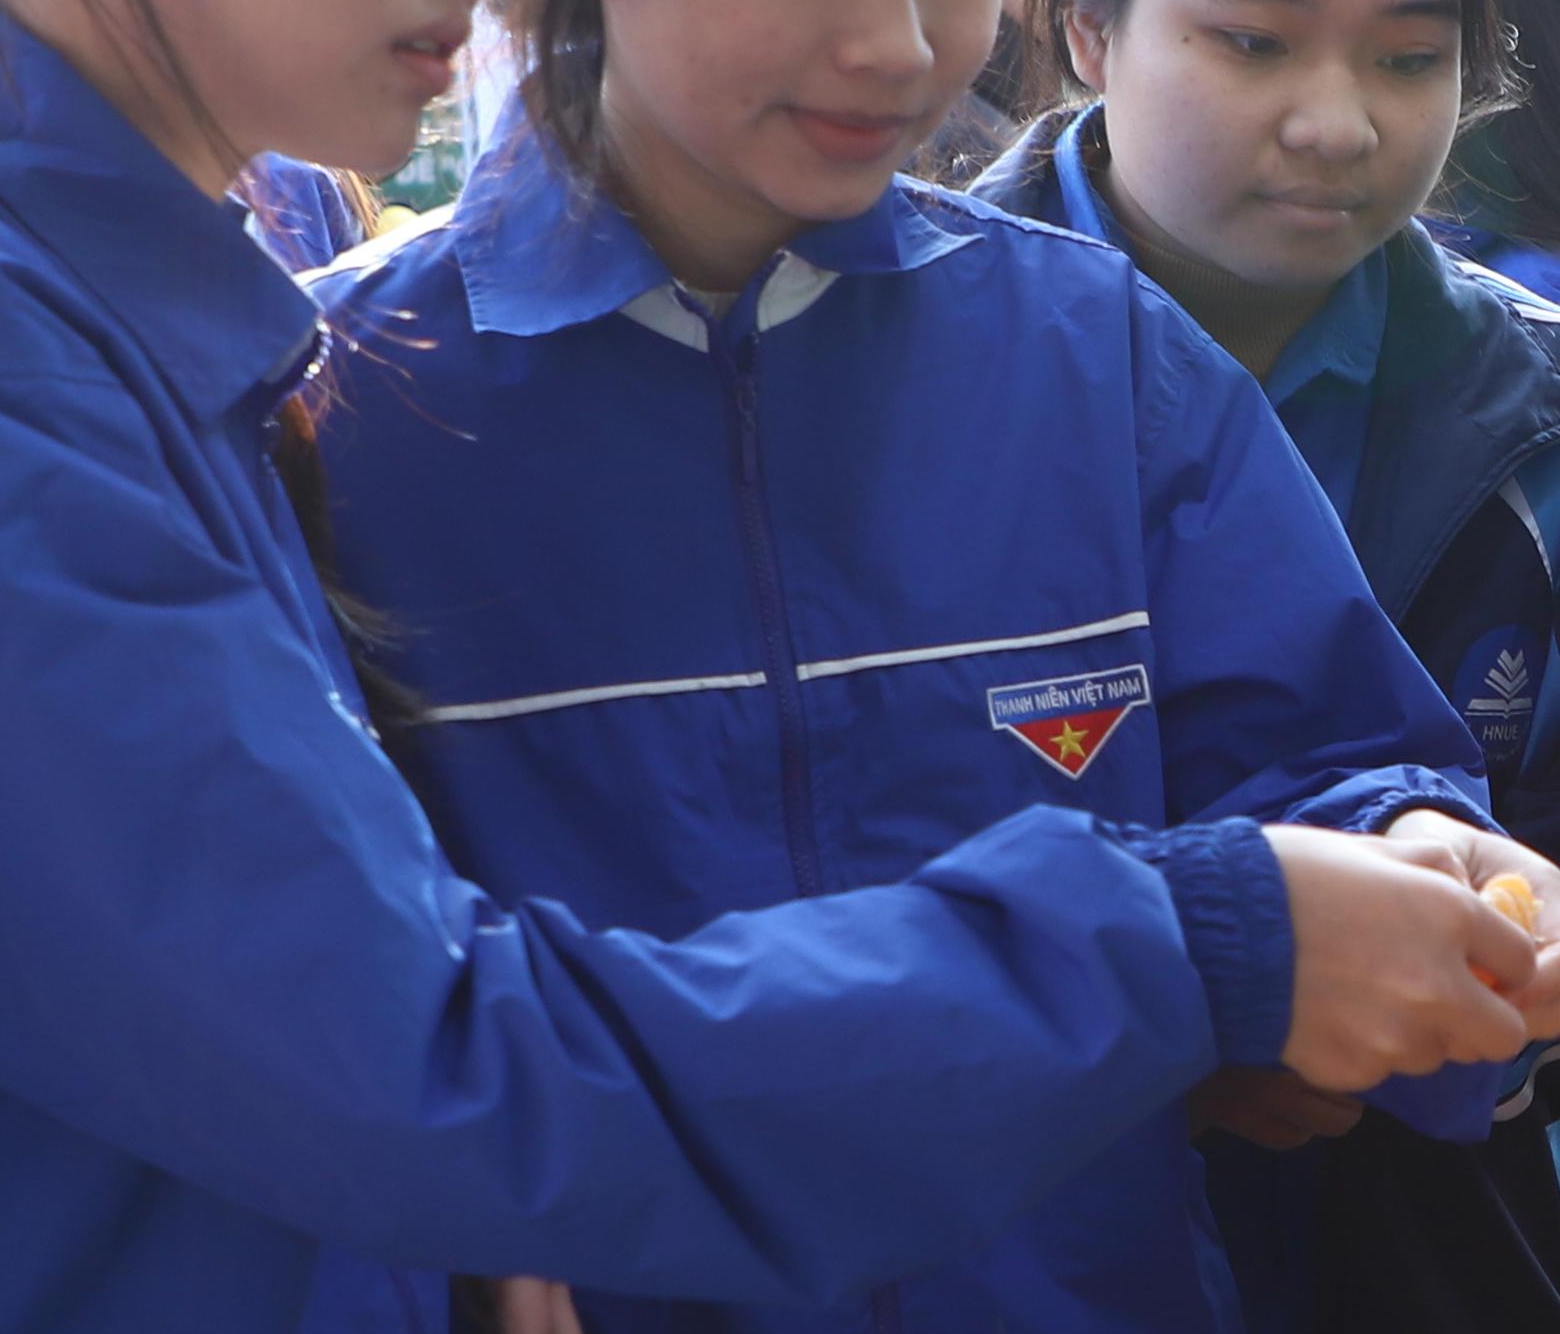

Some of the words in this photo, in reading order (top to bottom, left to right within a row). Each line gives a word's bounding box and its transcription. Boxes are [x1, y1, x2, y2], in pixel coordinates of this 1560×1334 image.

[994, 695, 1034, 717] THANH
[1035, 685, 1070, 710] NIÊN
[1071, 680, 1104, 707] VIỆT
[1107, 677, 1142, 701] NAM
[1482, 724, 1519, 741] HNUE
